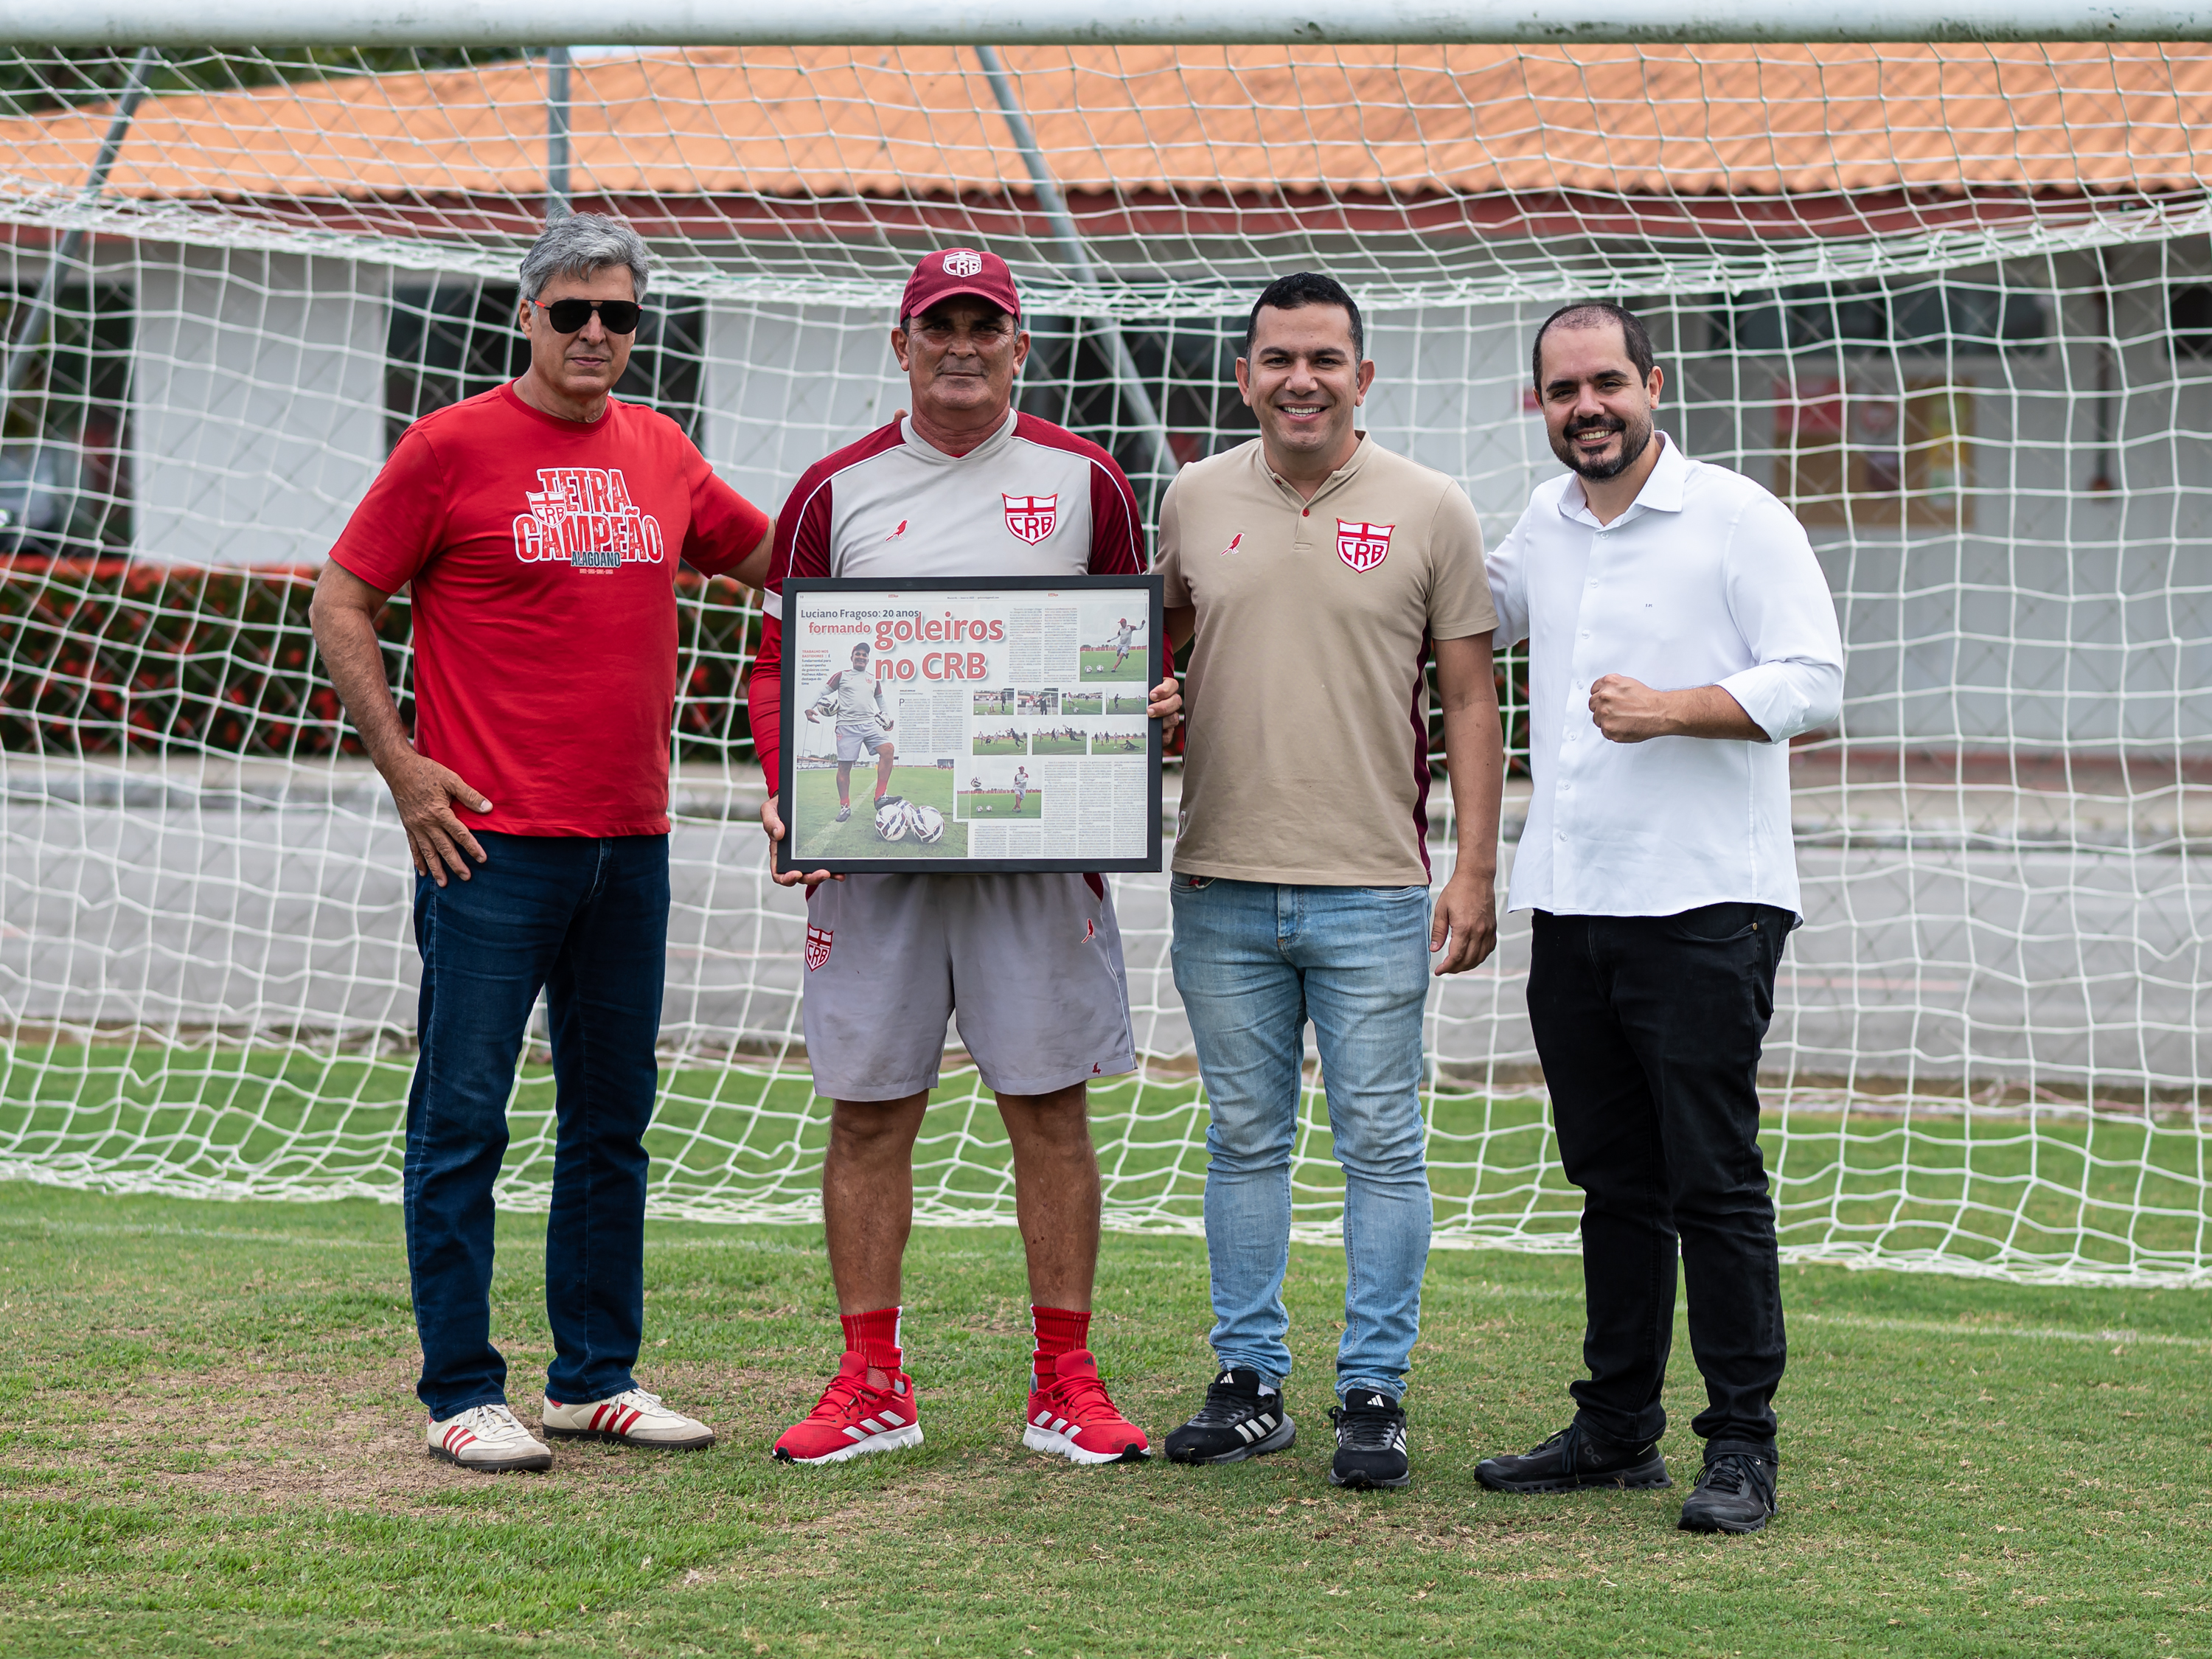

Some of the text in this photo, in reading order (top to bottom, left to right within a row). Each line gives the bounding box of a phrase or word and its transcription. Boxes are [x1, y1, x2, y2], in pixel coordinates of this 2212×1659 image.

[945, 260, 980, 275] CRB
[538, 468, 632, 515] TETRA
[534, 507, 565, 524] CRB
[513, 506, 664, 563] CAMPEÃO
[1009, 517, 1052, 540] CRB
[571, 551, 622, 568] ALAGOANO
[1341, 541, 1385, 567] CRB
[801, 609, 838, 618] Luciano
[840, 609, 881, 620] Fragoso:
[809, 611, 1004, 650] formando goleiros
[875, 652, 987, 679] no CRB
[808, 944, 827, 967] CRB
